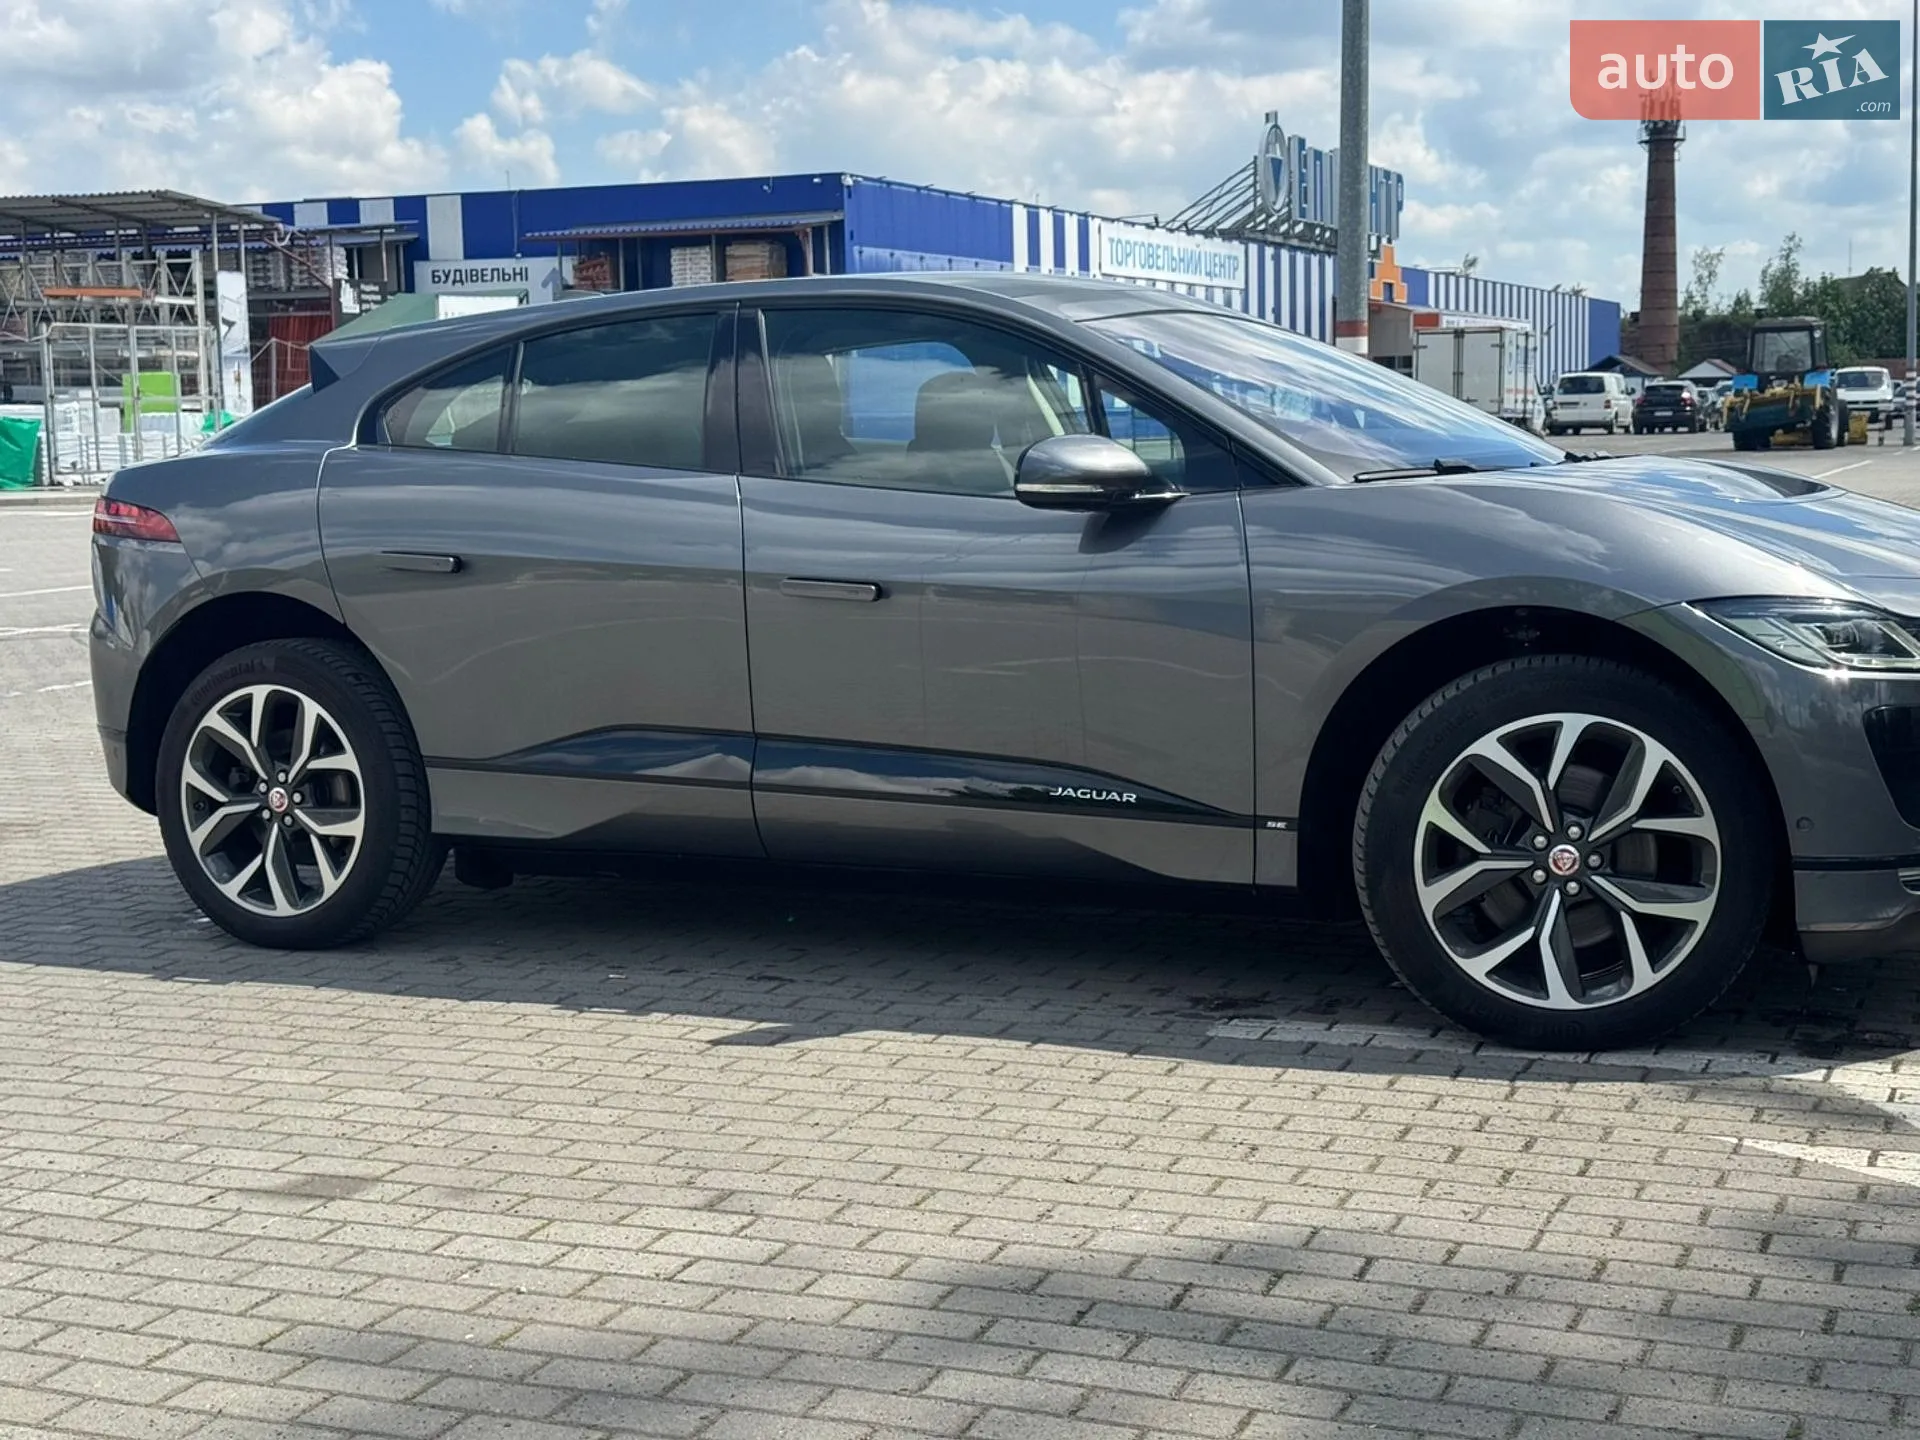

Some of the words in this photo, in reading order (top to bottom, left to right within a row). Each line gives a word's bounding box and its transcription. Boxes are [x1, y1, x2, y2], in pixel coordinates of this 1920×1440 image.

[1108, 237, 1202, 276] ТОРГОВЕЛЬНИЙ
[1203, 250, 1240, 281] ЦЕНТР
[431, 266, 529, 286] БУДІВЕЛЬНІ
[1049, 787, 1137, 803] JAGUAR
